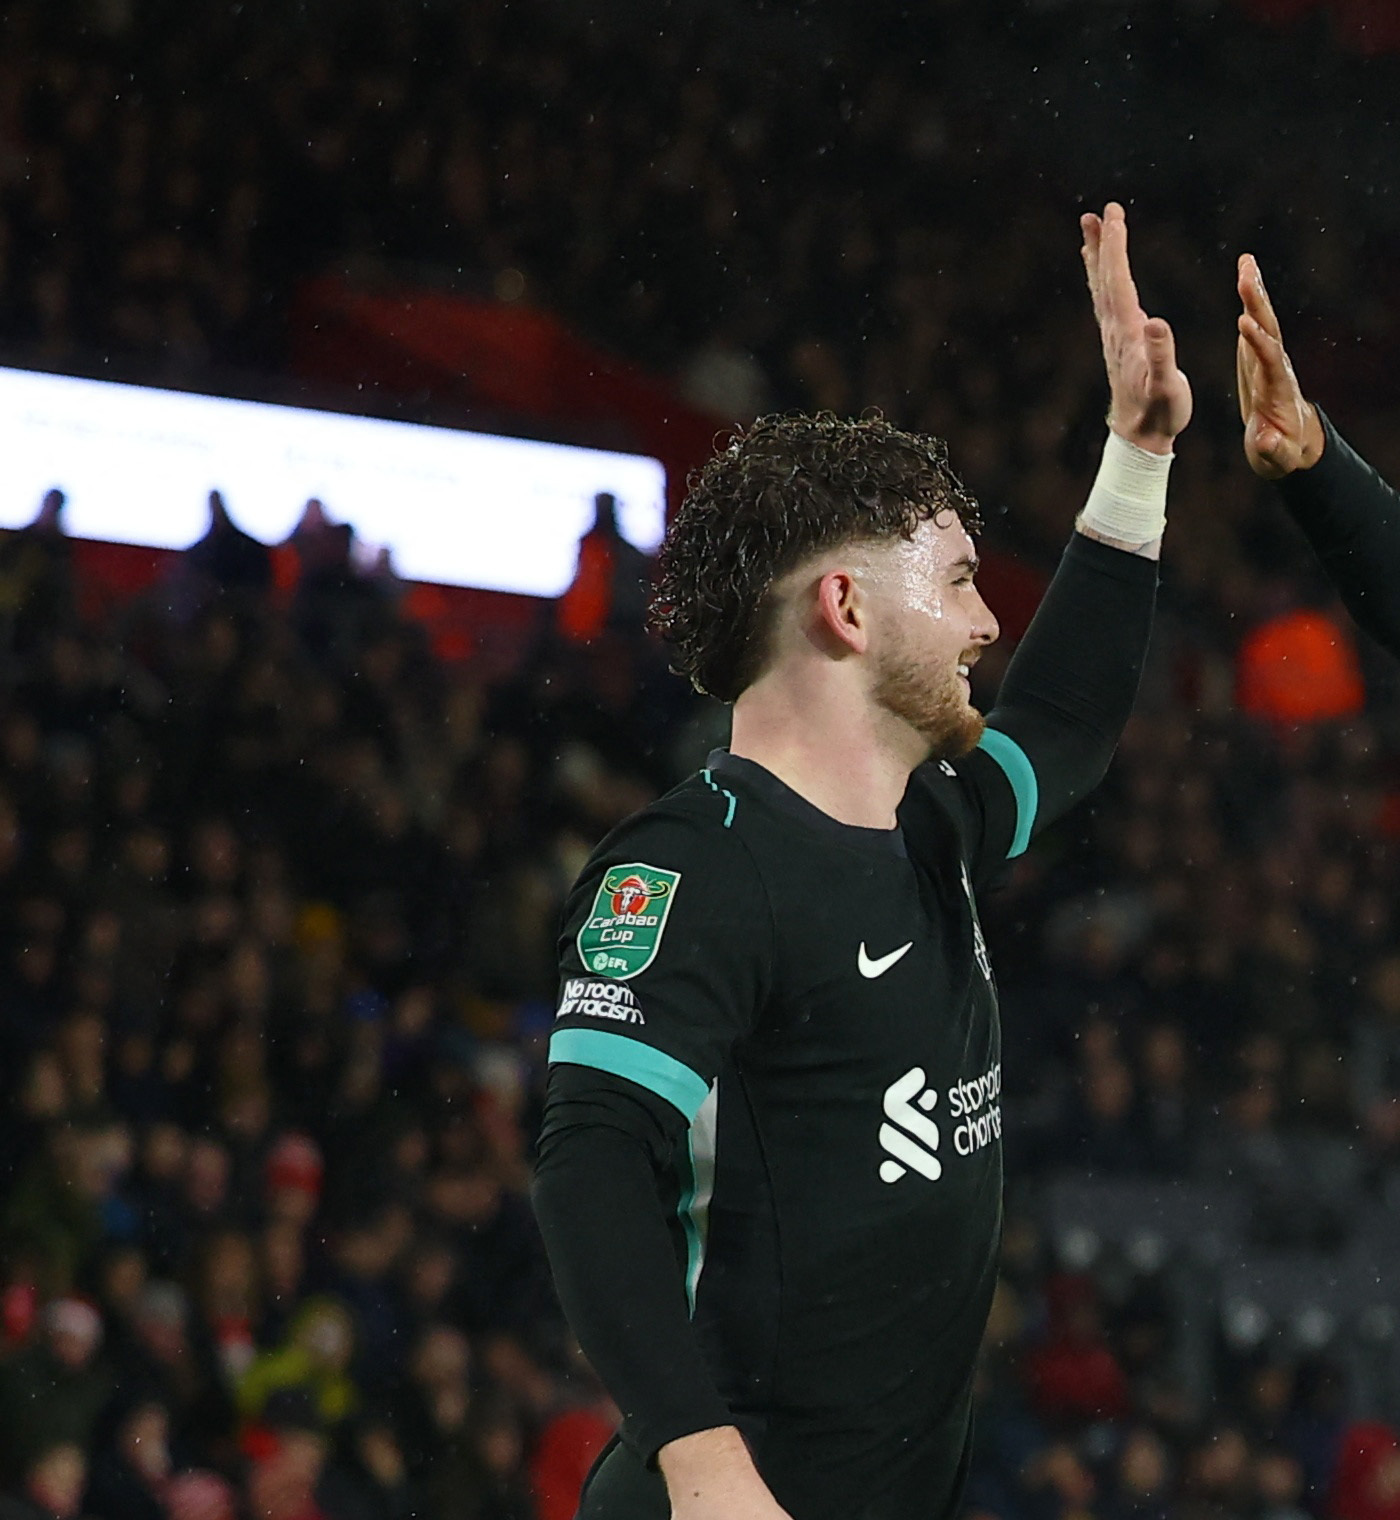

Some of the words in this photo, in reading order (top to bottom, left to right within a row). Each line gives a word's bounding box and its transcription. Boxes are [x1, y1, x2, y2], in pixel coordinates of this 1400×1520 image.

[588, 912, 659, 929] Carabao
[600, 929, 634, 943] Cup
[607, 957, 629, 972] EFL
[584, 981, 635, 1006] room
[576, 999, 646, 1025] racism
